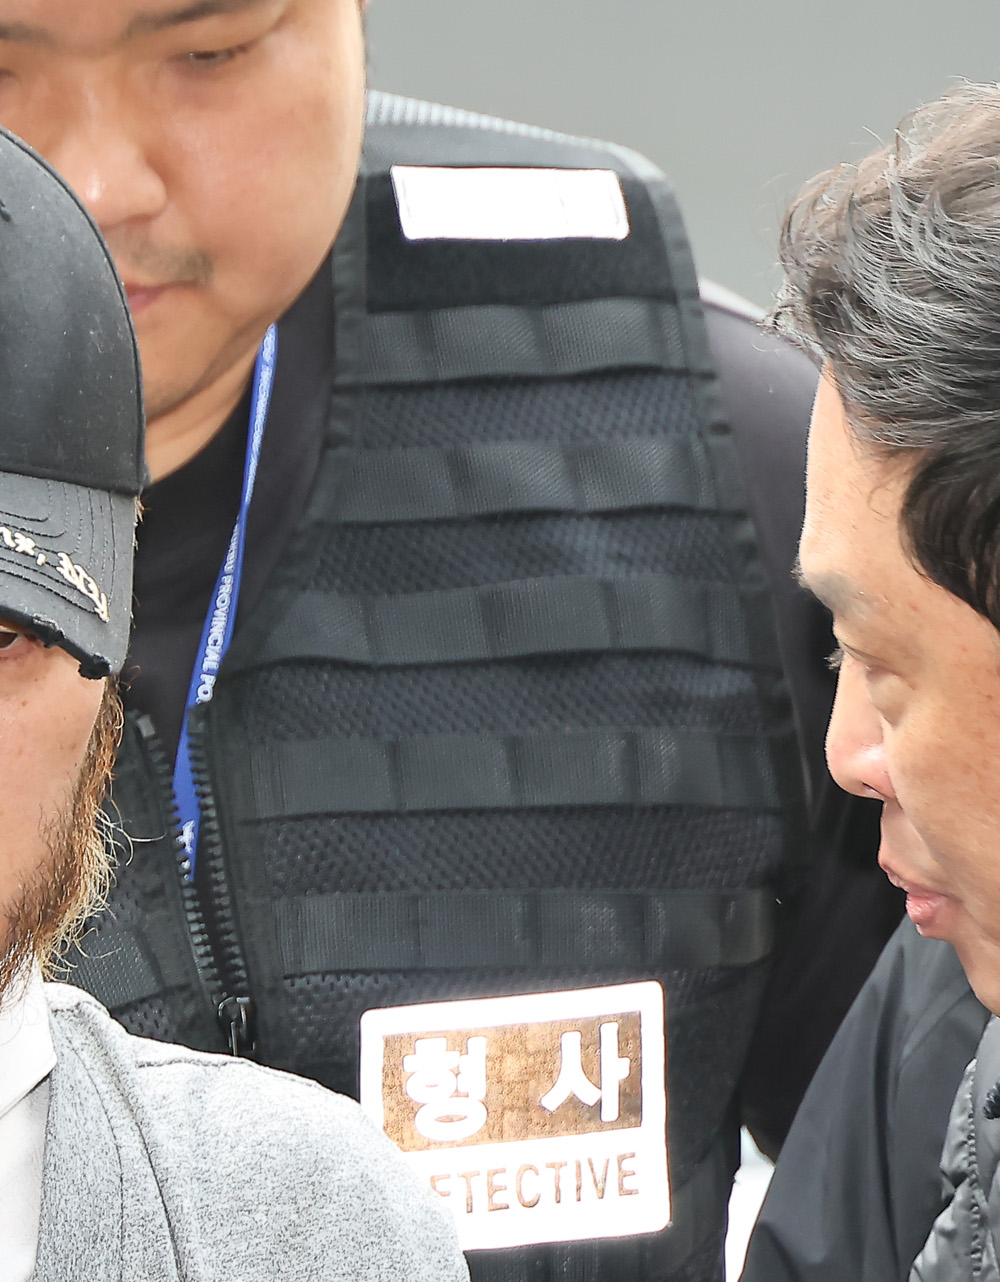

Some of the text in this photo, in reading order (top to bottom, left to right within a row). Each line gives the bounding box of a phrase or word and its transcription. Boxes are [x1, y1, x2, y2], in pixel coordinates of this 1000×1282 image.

[202, 574, 234, 672] PROVINCIAL
[196, 673, 217, 704] PO
[429, 1152, 640, 1214] ETECTIVE
